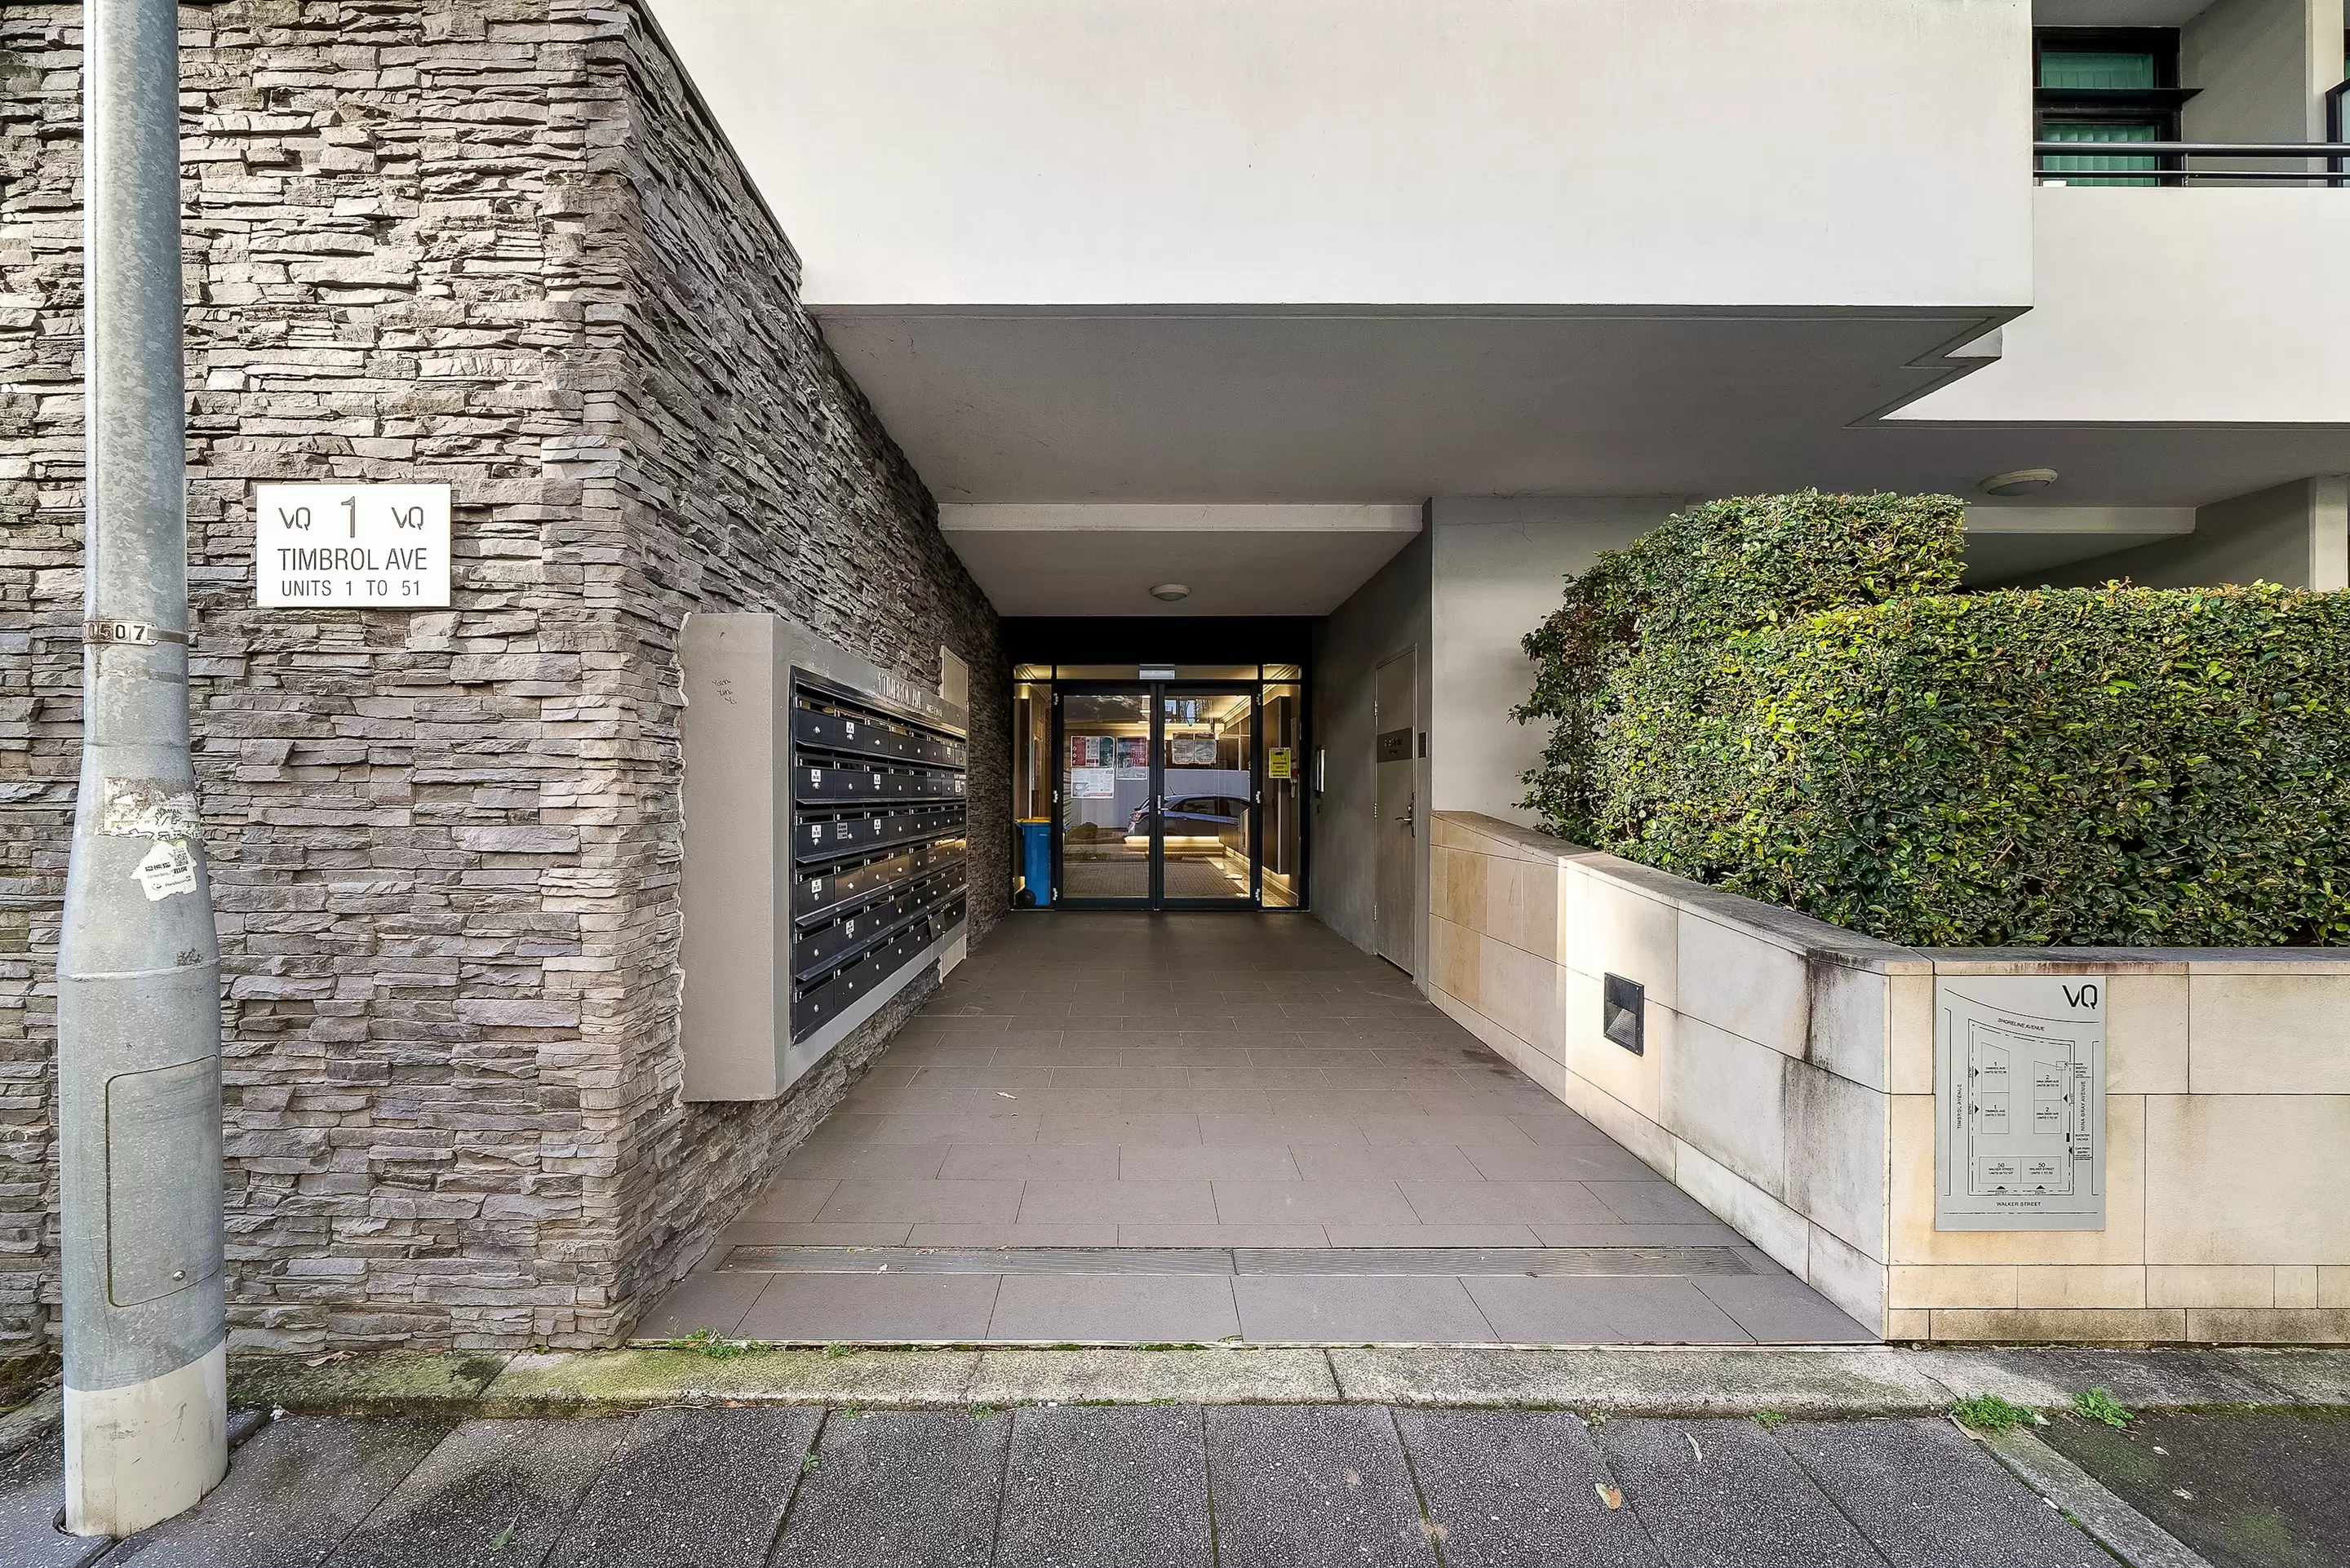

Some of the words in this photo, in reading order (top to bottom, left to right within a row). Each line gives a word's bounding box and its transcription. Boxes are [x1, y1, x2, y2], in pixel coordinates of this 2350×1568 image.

[278, 507, 311, 530] VQ
[341, 495, 356, 538] 1
[391, 506, 424, 530] VQ
[277, 547, 379, 571] TIMBROL
[385, 547, 428, 570] AVE
[282, 579, 332, 596] UNITS
[345, 580, 352, 596] 1
[366, 580, 388, 596] TO
[401, 580, 420, 596] 51
[2062, 984, 2098, 1010] VQ
[1998, 1018, 2025, 1028] SHORELINE
